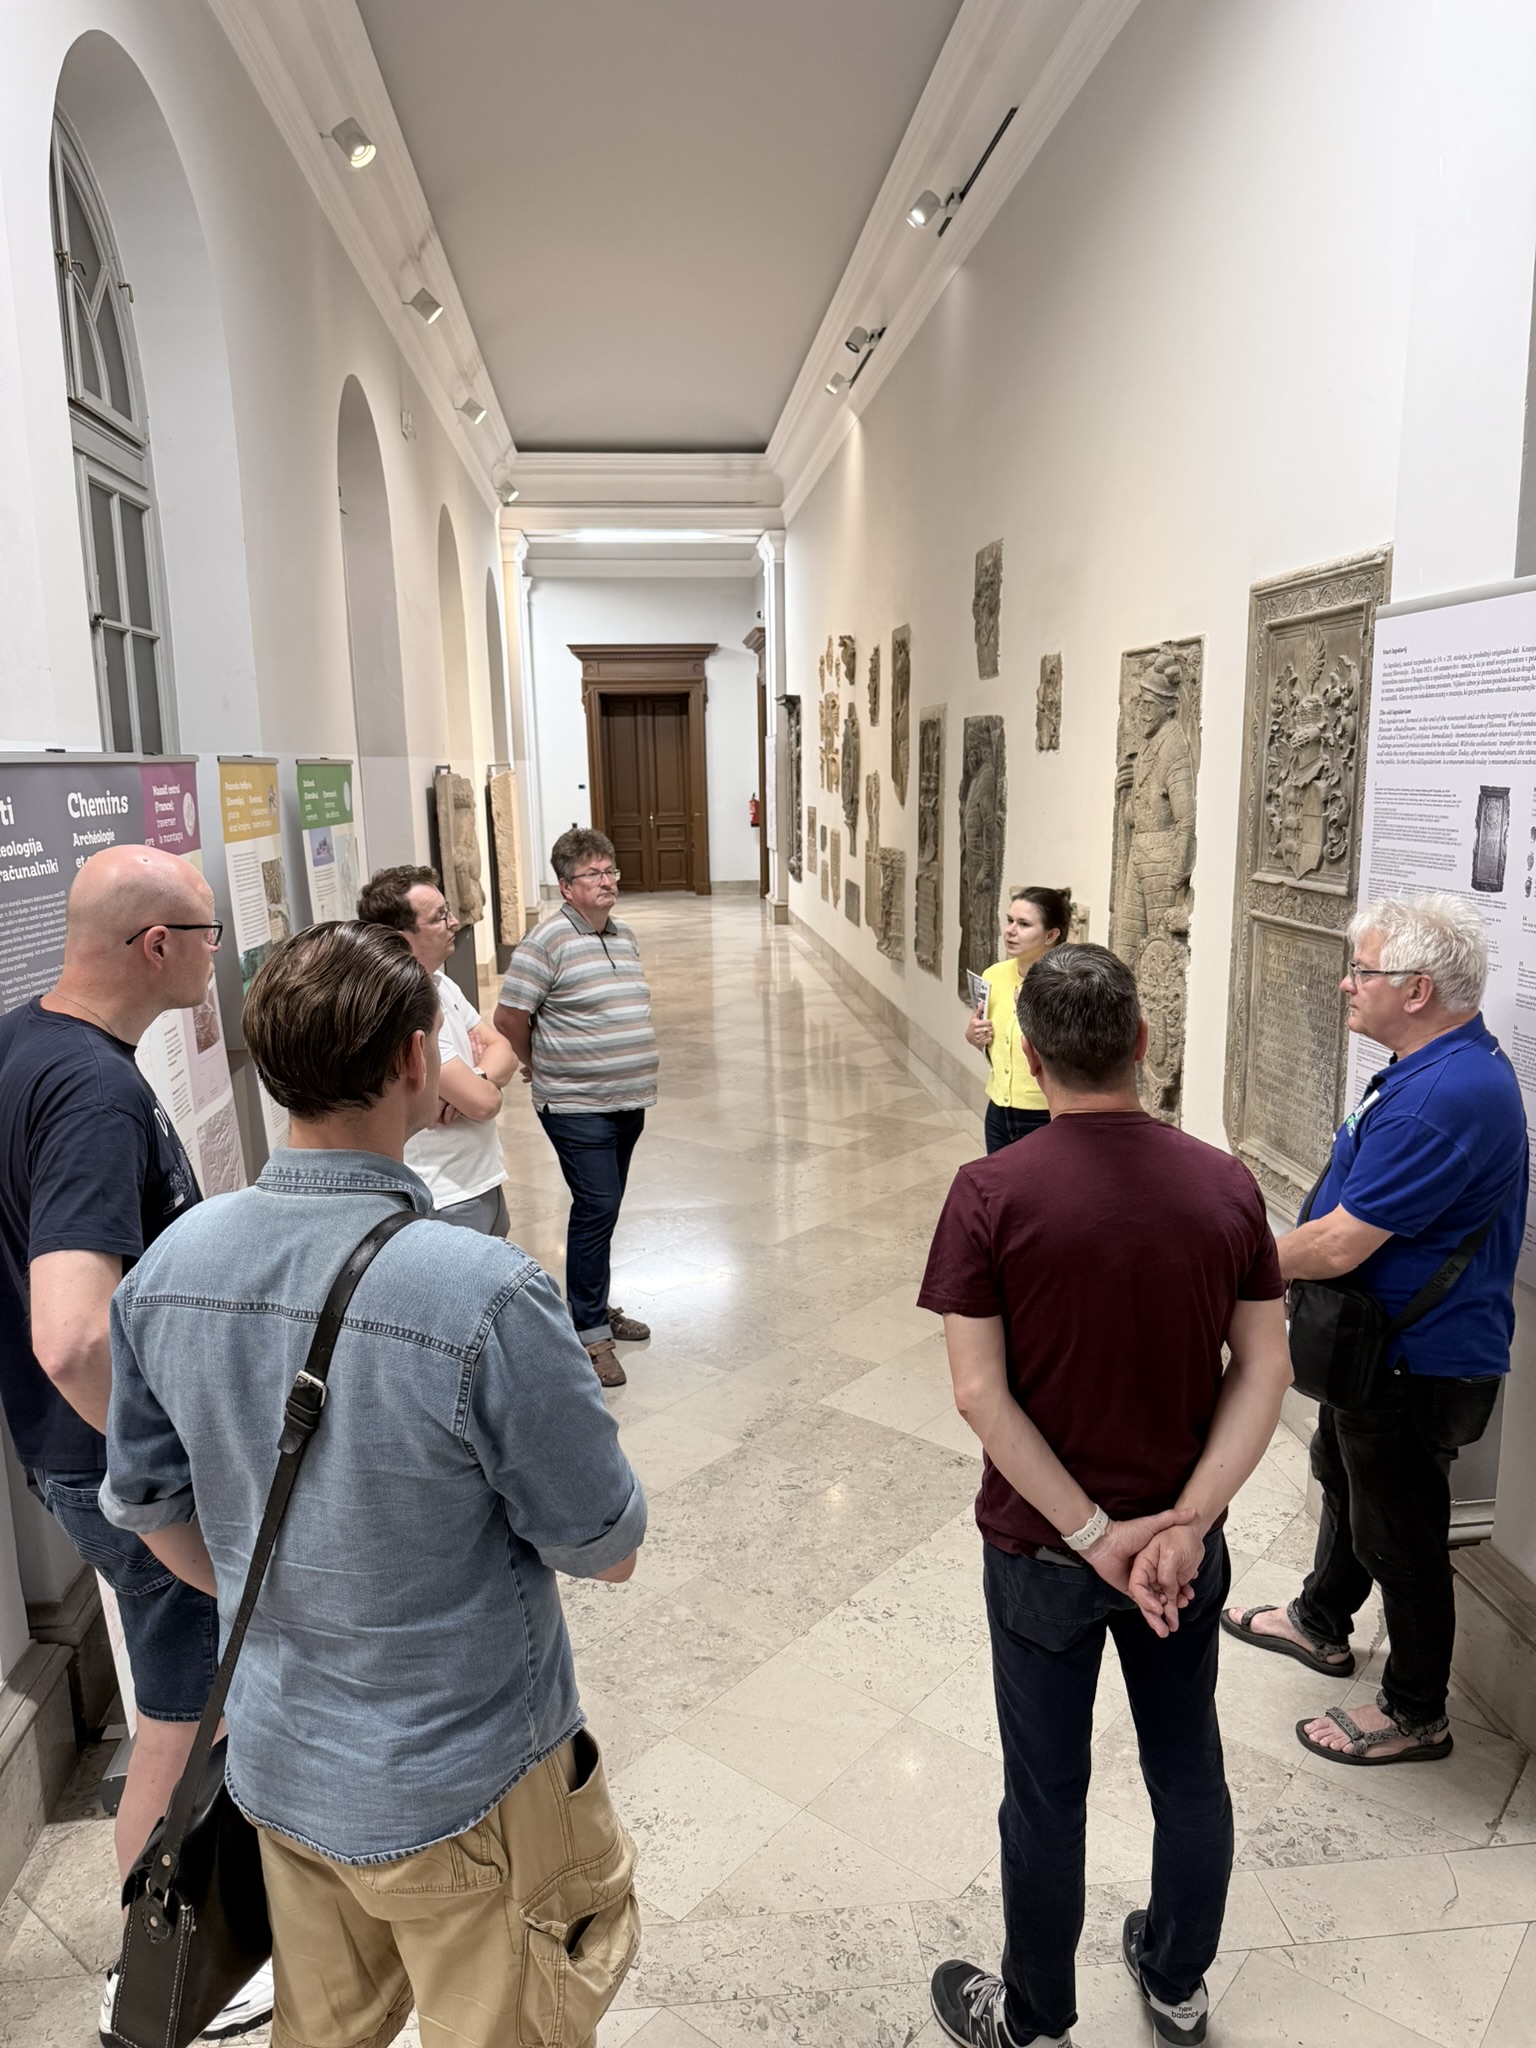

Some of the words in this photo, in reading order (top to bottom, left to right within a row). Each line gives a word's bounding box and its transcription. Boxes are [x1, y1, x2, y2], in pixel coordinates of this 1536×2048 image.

[0, 796, 15, 826] ti
[67, 789, 129, 818] Chemins
[73, 828, 115, 847] Archéologie
[0, 838, 44, 858] eologija
[75, 855, 85, 871] et
[1171, 2010, 1199, 2019] balance
